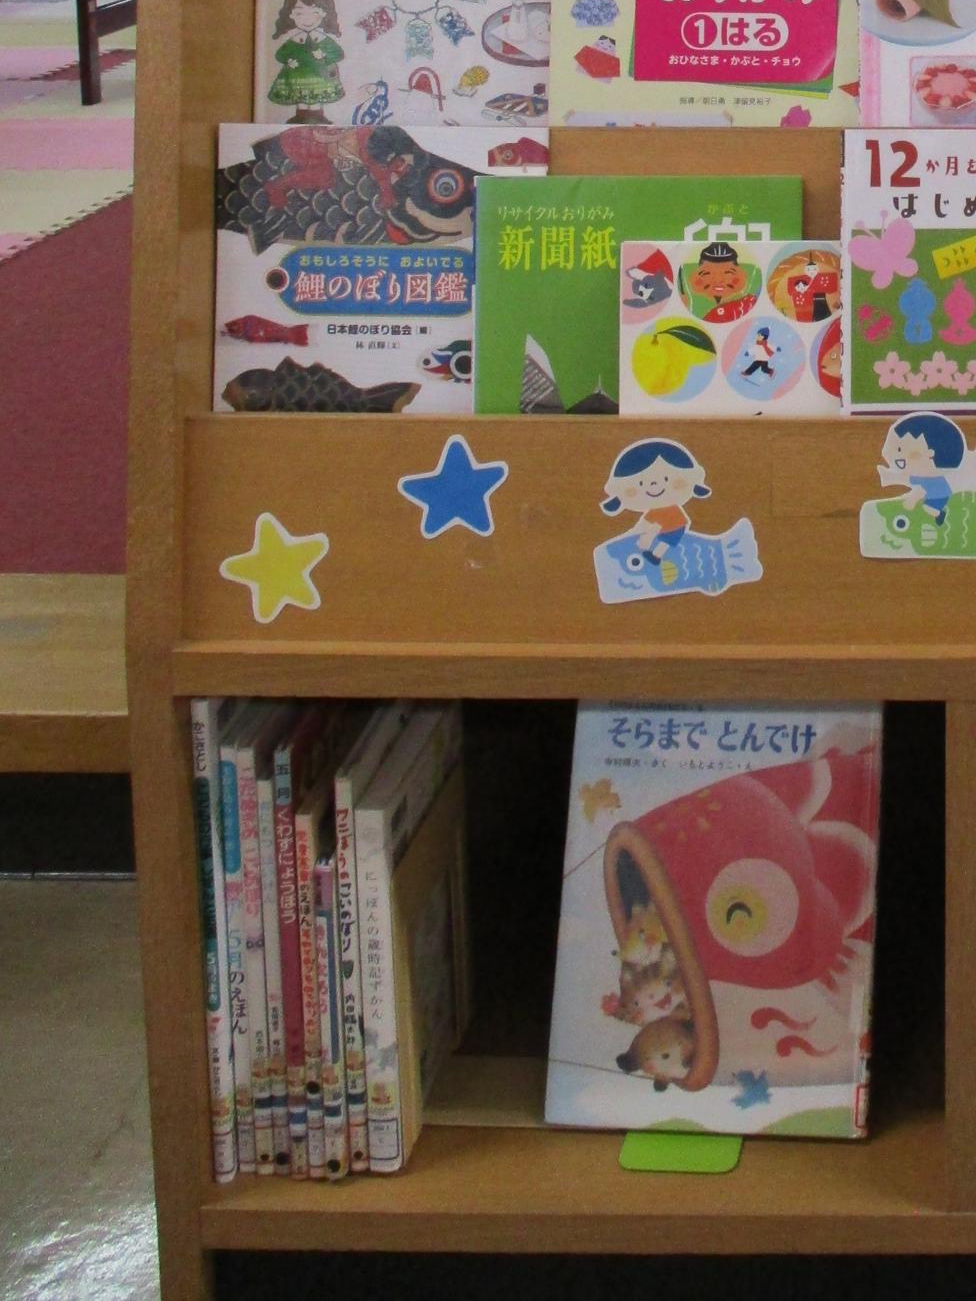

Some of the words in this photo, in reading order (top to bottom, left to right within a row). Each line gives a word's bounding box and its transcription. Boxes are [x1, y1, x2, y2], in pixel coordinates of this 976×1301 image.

[668, 54, 801, 67] おひなさま・かぶと・チョウ
[498, 205, 615, 221] リサイクルおりがみ
[299, 255, 389, 267] おもしろそうに
[400, 255, 465, 268] およいでる
[498, 224, 617, 271] 新聞紙
[295, 269, 468, 304] 鯉のぼり図鑑
[327, 323, 413, 336] 日本鯉のぼり協会
[607, 716, 707, 751] そらまで
[717, 719, 817, 755] とんでけ
[363, 870, 383, 1021] にっぽんの歳時記ずかん
[228, 928, 248, 1036] 5月のえほん
